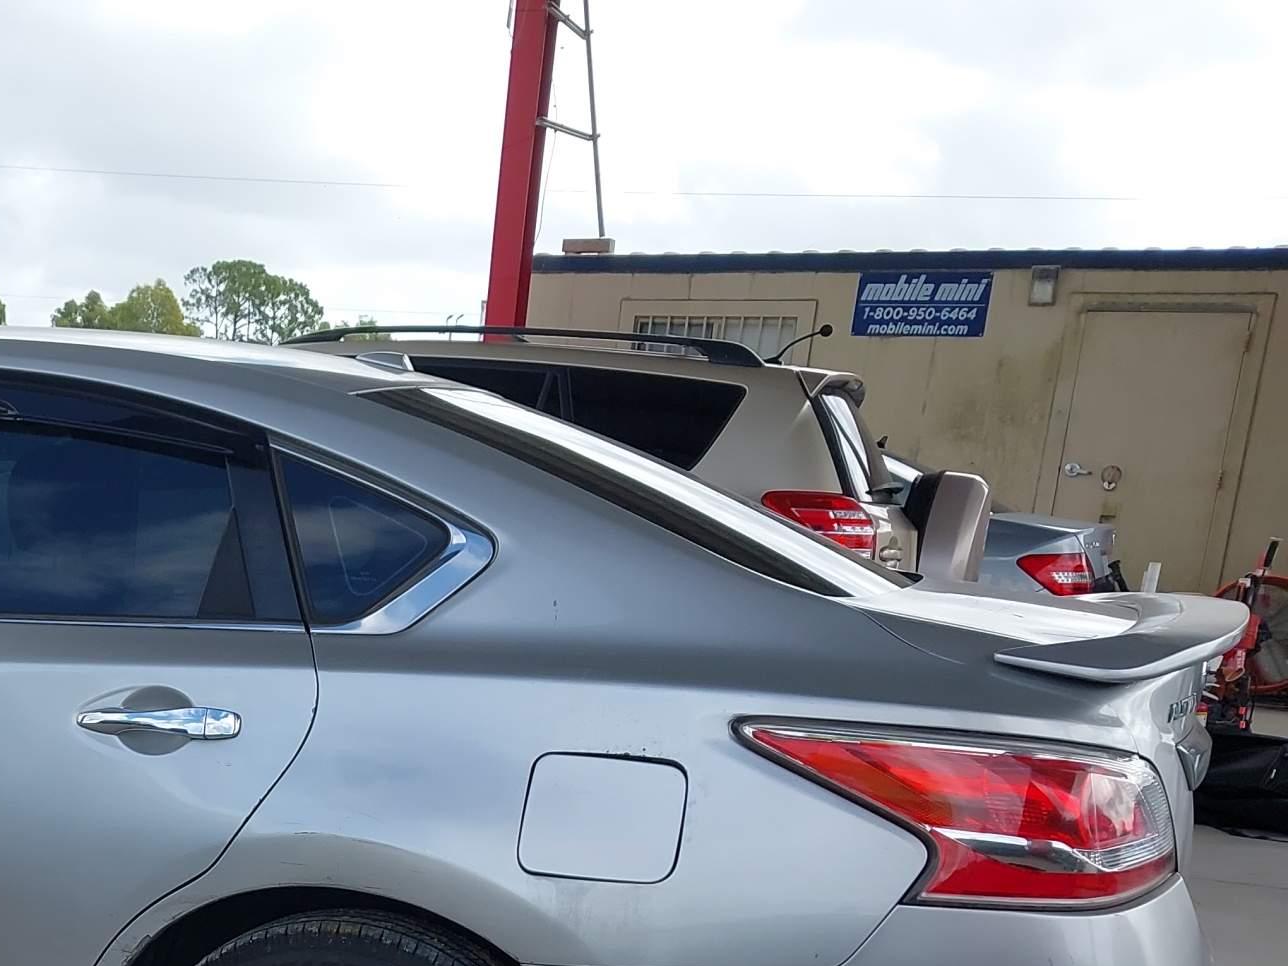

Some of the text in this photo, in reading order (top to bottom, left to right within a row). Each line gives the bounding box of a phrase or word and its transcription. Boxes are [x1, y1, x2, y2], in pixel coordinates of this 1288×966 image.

[860, 274, 987, 301] mobile mini
[863, 307, 977, 320] 1-800-950-6464
[866, 322, 969, 335] mobilemini.com
